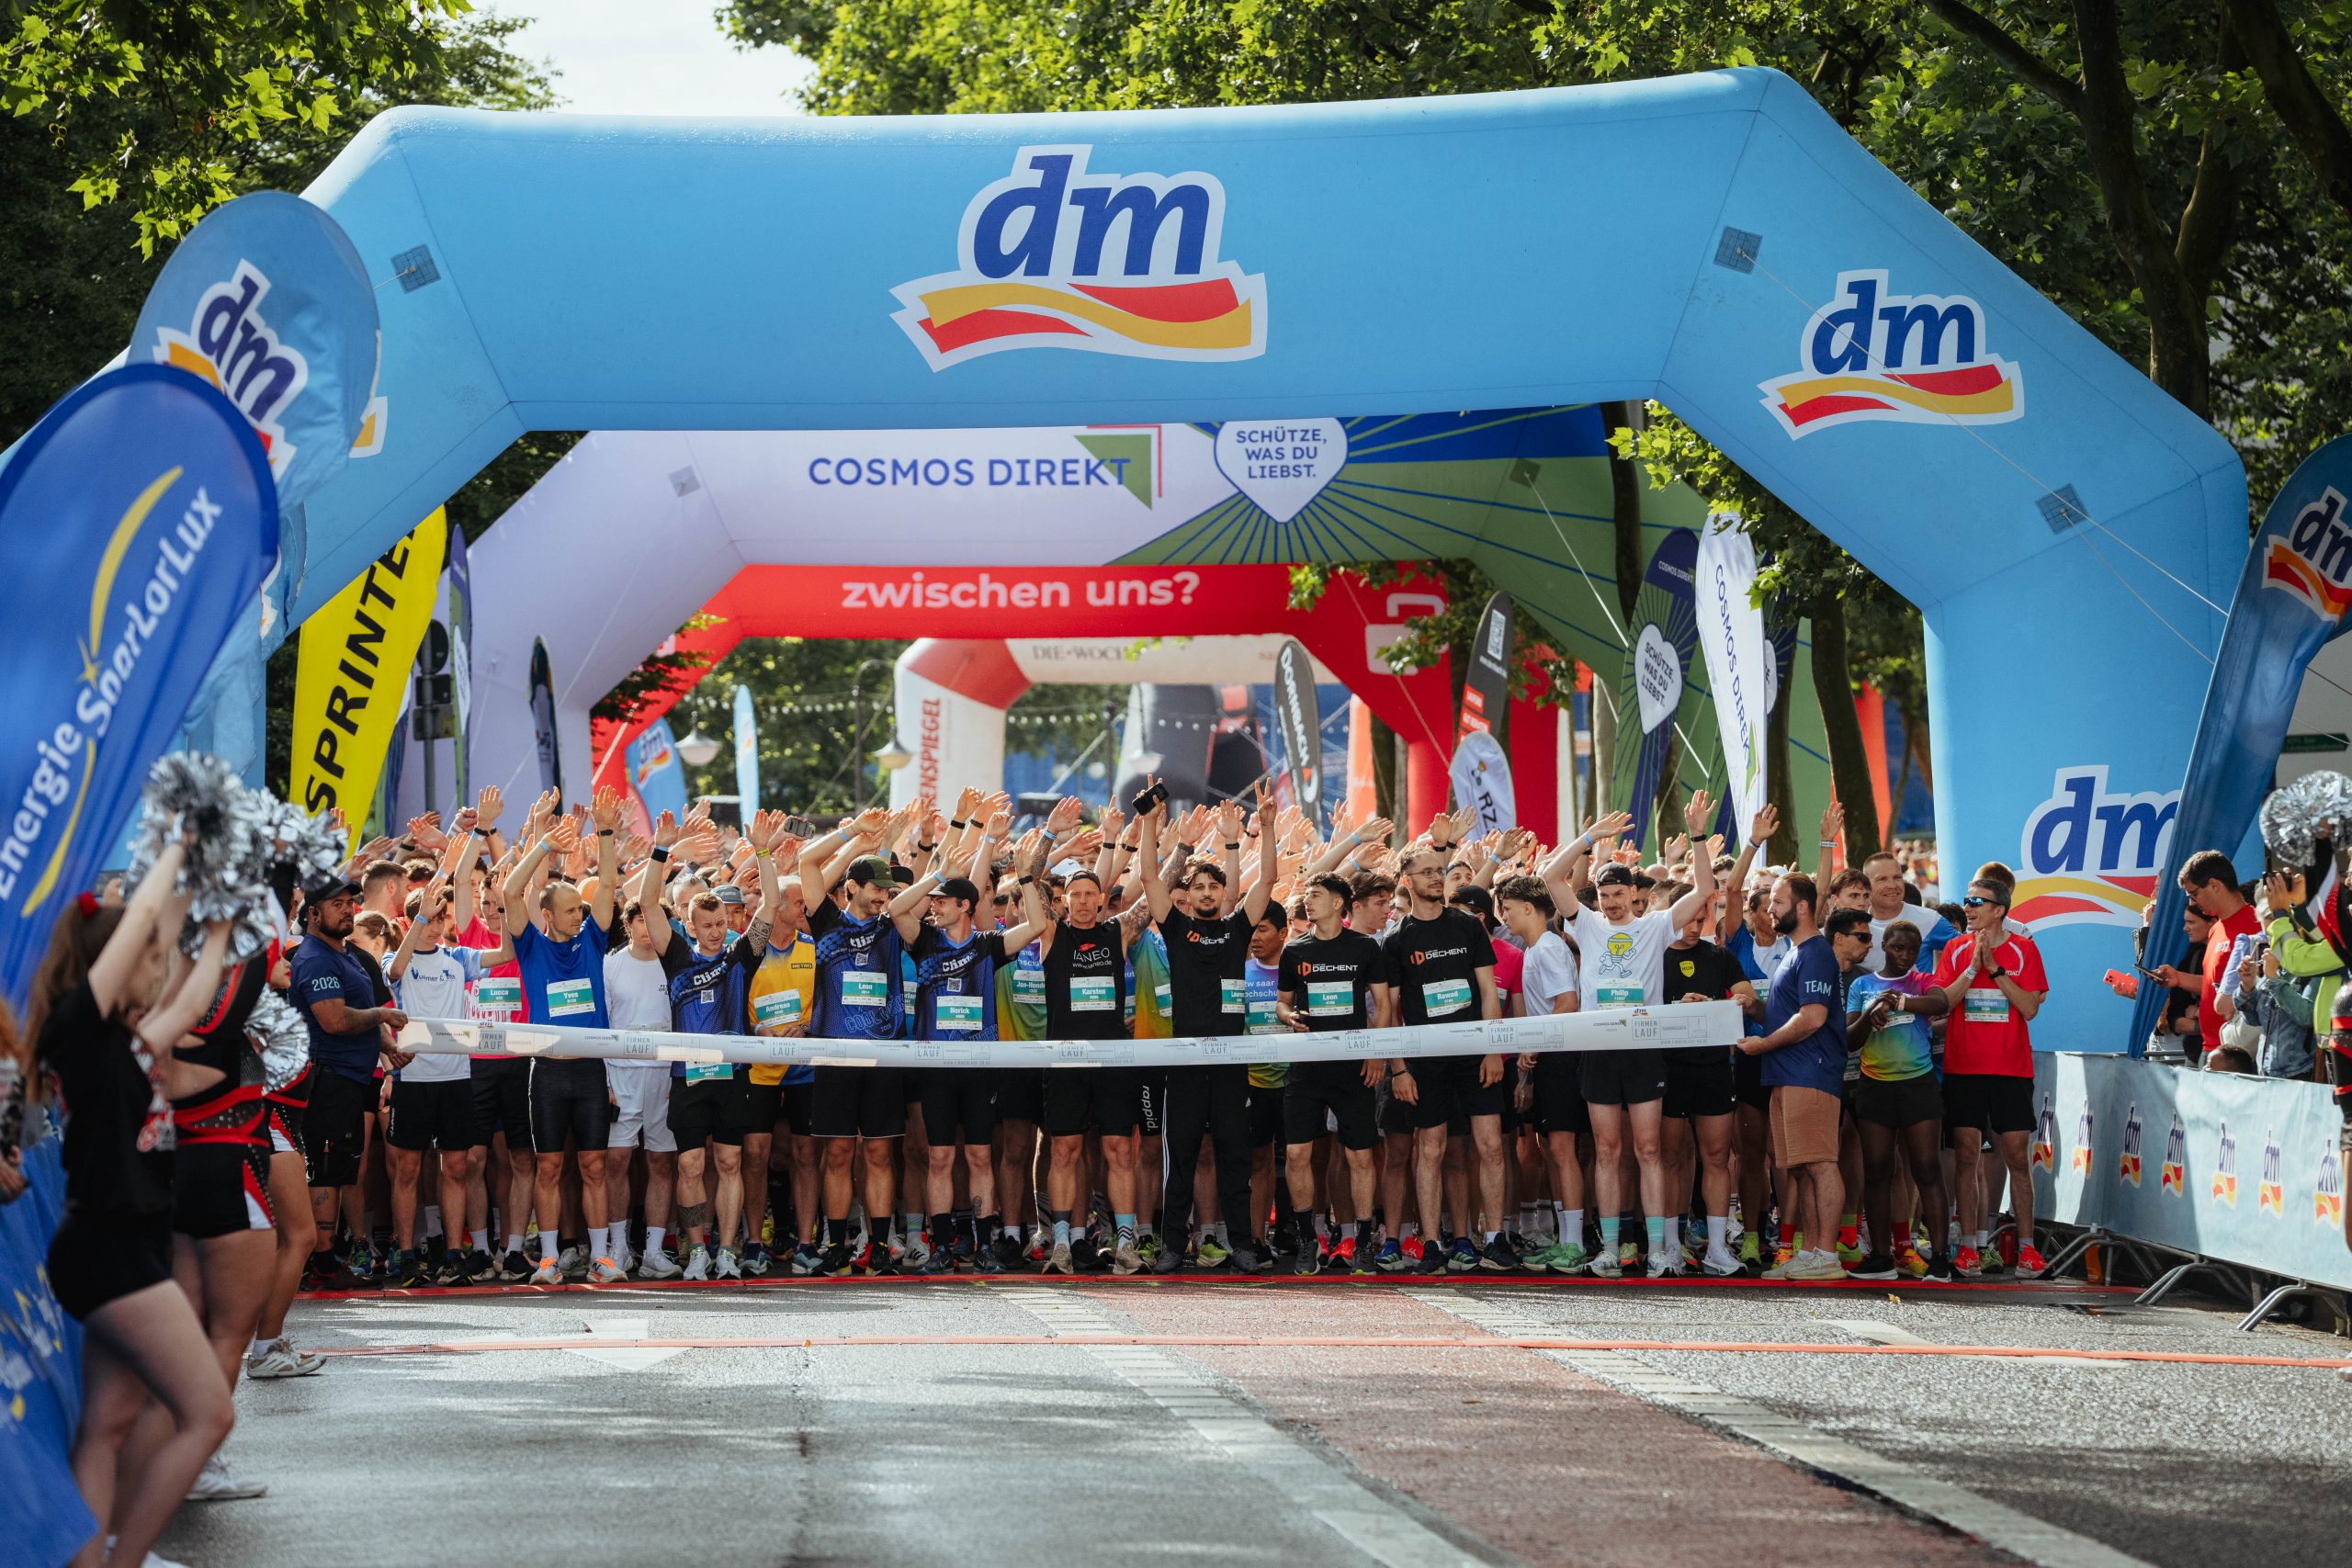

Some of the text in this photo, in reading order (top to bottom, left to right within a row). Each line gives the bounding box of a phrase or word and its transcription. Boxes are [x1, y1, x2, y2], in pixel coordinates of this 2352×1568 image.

[974, 154, 1209, 278] dm
[1811, 278, 1975, 375] dm
[198, 274, 296, 422] dm
[1236, 425, 1328, 446] SCHÜTZE,
[1245, 446, 1318, 461] WAS DU
[808, 457, 1131, 485] COSMOS DIREKT
[1248, 464, 1317, 479] LIEBST.
[1658, 560, 1678, 576] COSMOS
[842, 571, 1200, 608] zwischen uns?
[1715, 564, 1737, 673] COSMOS
[1645, 641, 1675, 683] SCHÜTZE,
[306, 530, 415, 815] SPRINTE
[1644, 658, 1669, 692] WAS DU
[1641, 674, 1666, 708] LIEBST.
[920, 698, 941, 808] ENSPIEGEL
[1478, 791, 1500, 832] RZ
[2030, 776, 2178, 874] dm
[1426, 947, 1468, 961] DECHENT
[311, 976, 340, 992] 2026
[1245, 989, 1278, 998] ochschu
[1804, 980, 1832, 997] TEAM
[1491, 1033, 1515, 1043] LAUF
[1634, 1028, 1657, 1038] LAUF
[478, 1041, 503, 1050] LAUF
[626, 1044, 650, 1054] LAUF
[772, 1047, 796, 1056] LAUF
[918, 1049, 941, 1057] LAUF
[1348, 1041, 1371, 1049] LAUF
